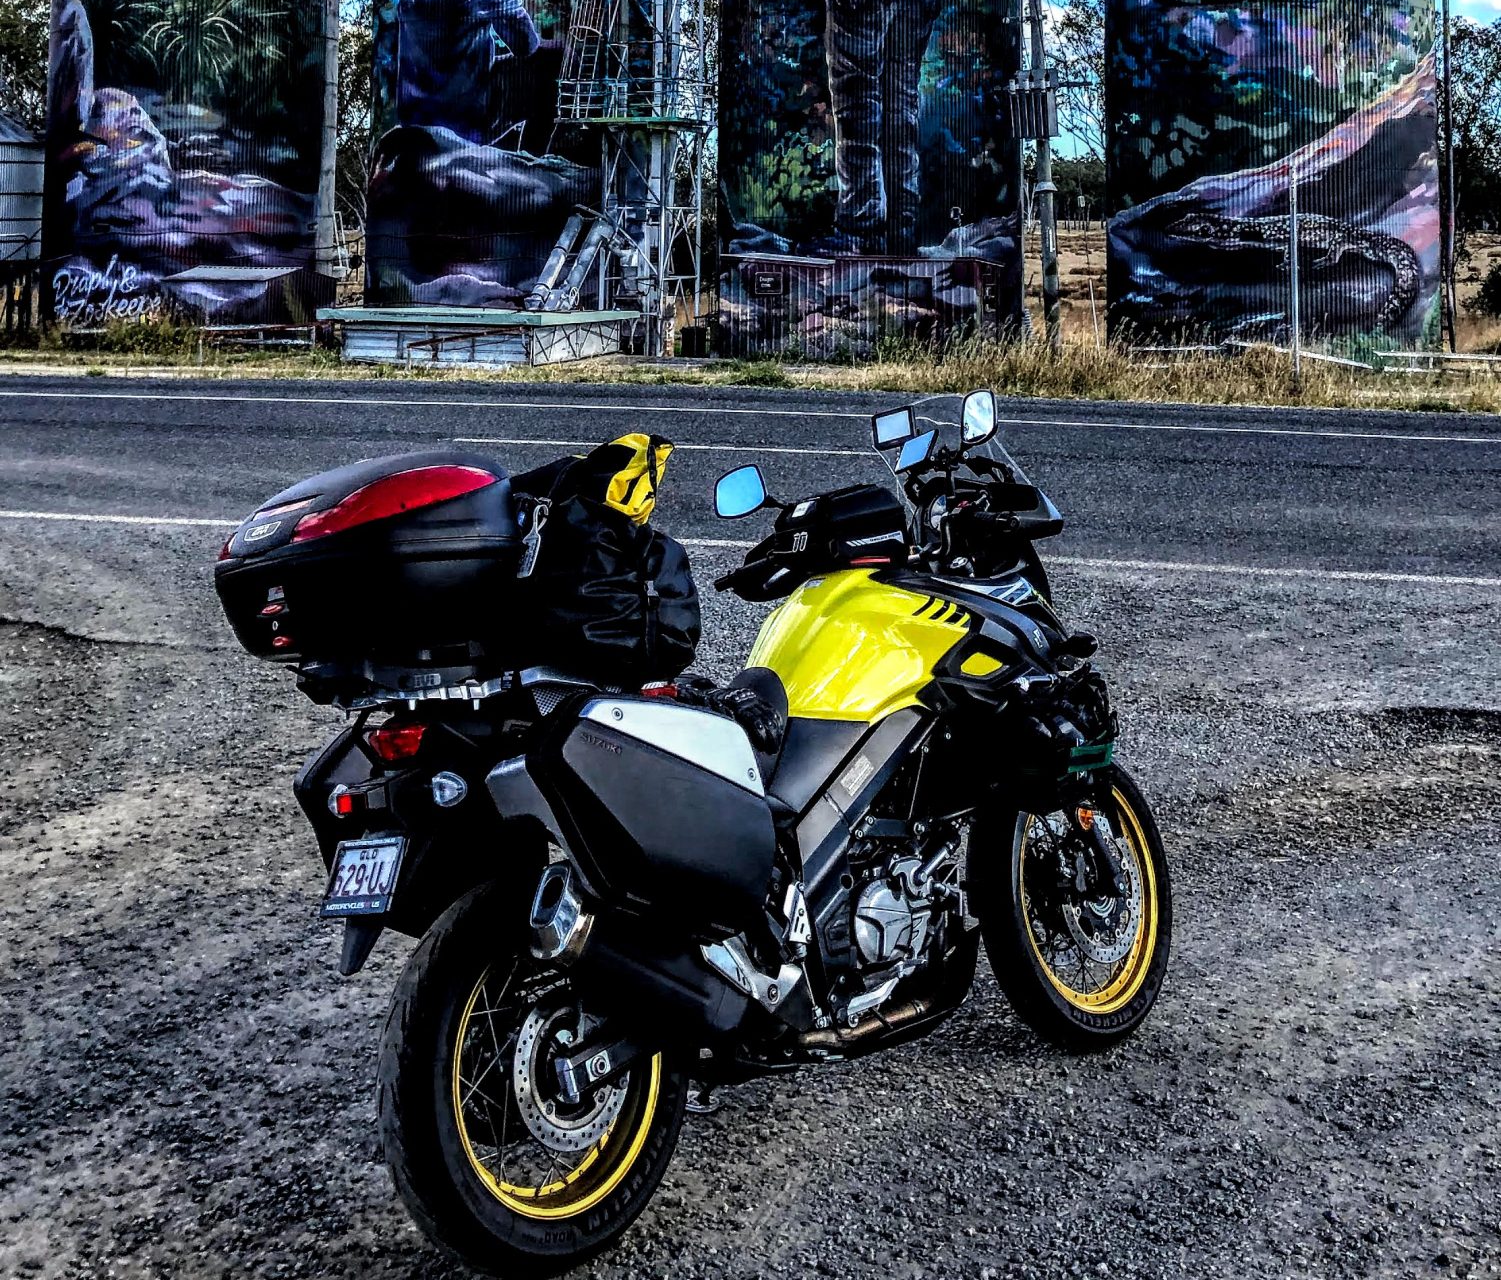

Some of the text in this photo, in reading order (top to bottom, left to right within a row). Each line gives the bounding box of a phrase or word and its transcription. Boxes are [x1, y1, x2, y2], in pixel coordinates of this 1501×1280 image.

[120, 266, 140, 293] &
[580, 732, 622, 755] SUZUKI
[1072, 1008, 1133, 1028] MICHELIN
